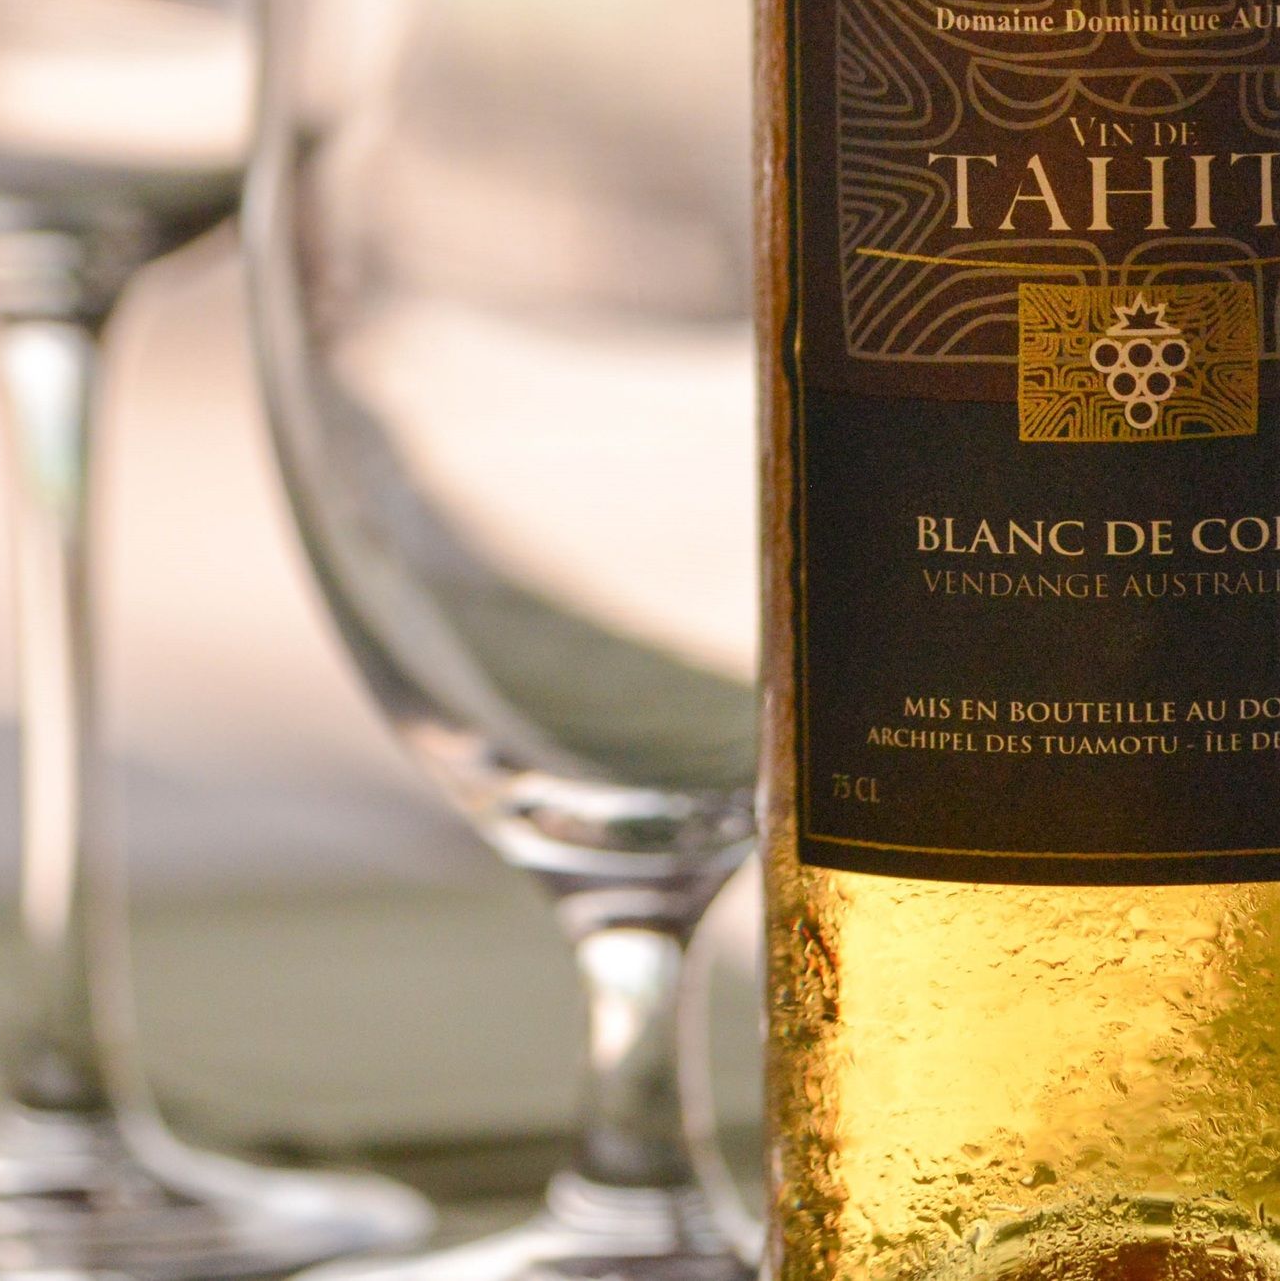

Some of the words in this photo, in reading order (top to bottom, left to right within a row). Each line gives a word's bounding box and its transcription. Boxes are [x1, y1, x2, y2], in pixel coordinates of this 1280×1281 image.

[935, 6, 1054, 34] Domaine
[1064, 8, 1221, 37] Dominique
[1069, 116, 1135, 147] VIN
[1153, 120, 1199, 147] DE
[915, 515, 1085, 558] BLANC
[1105, 520, 1173, 557] DE
[921, 568, 1109, 600] VENDANGE
[904, 696, 951, 719] MIS
[960, 699, 999, 722] EN
[1009, 701, 1176, 724] BOUTEILLE
[1185, 700, 1227, 723] AU
[866, 725, 978, 753] ARCHIPEL
[985, 734, 1033, 754] DES
[1039, 735, 1178, 756] TUAMOTU
[1204, 731, 1242, 754] ÎLE
[831, 773, 852, 799] 75
[855, 776, 881, 803] CL
